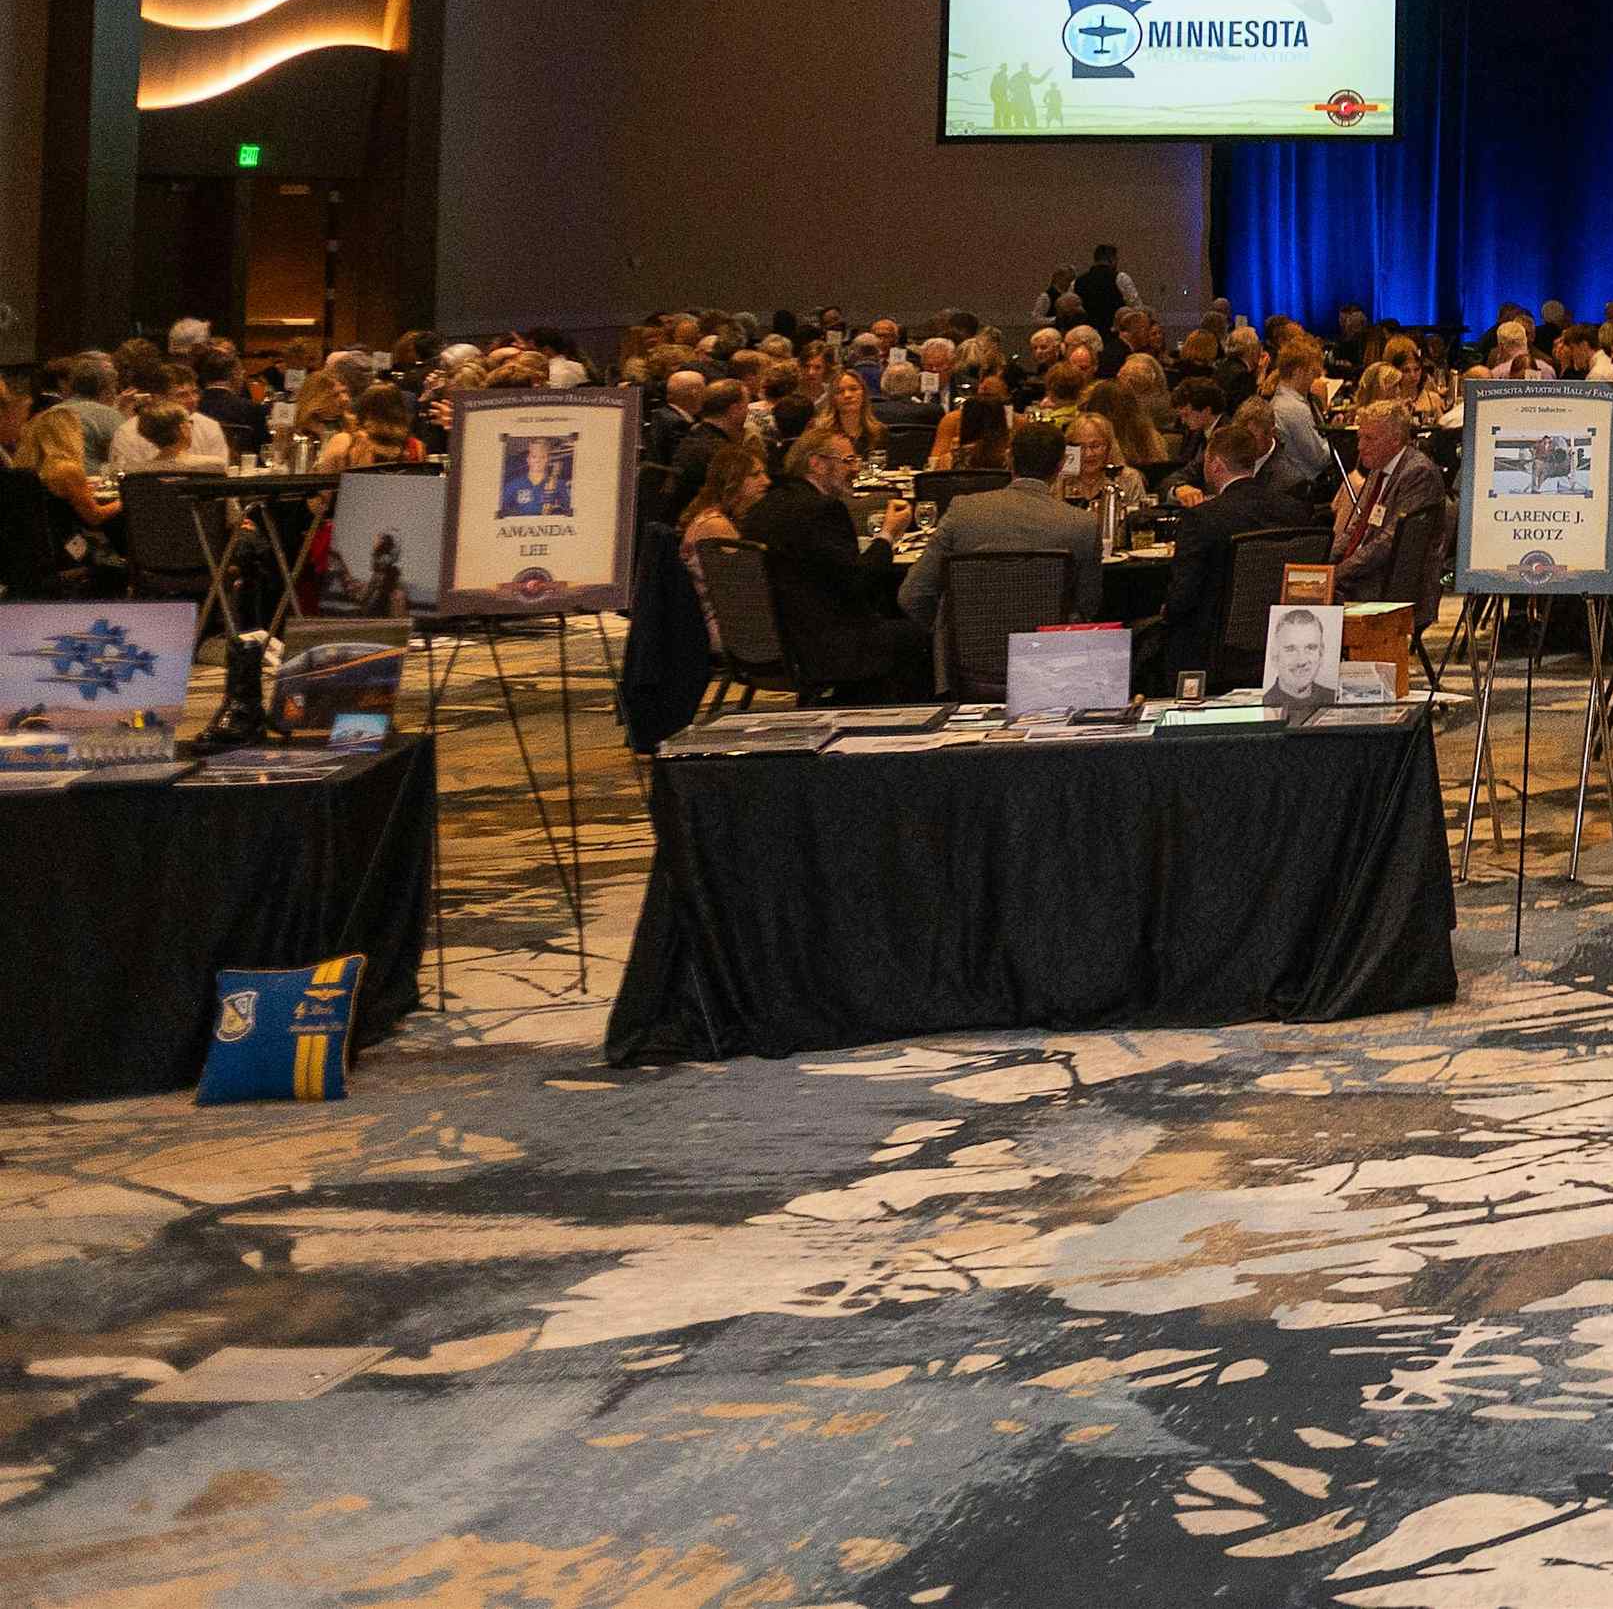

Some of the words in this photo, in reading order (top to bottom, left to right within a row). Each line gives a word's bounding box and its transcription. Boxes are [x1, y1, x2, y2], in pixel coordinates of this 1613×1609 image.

[1148, 20, 1309, 48] MINNESOTA
[1493, 510, 1571, 523] CLARENCE
[1573, 510, 1584, 524] J.
[496, 524, 577, 538] AMANDA
[1513, 528, 1564, 541] KROTZ
[519, 543, 550, 557] LEE
